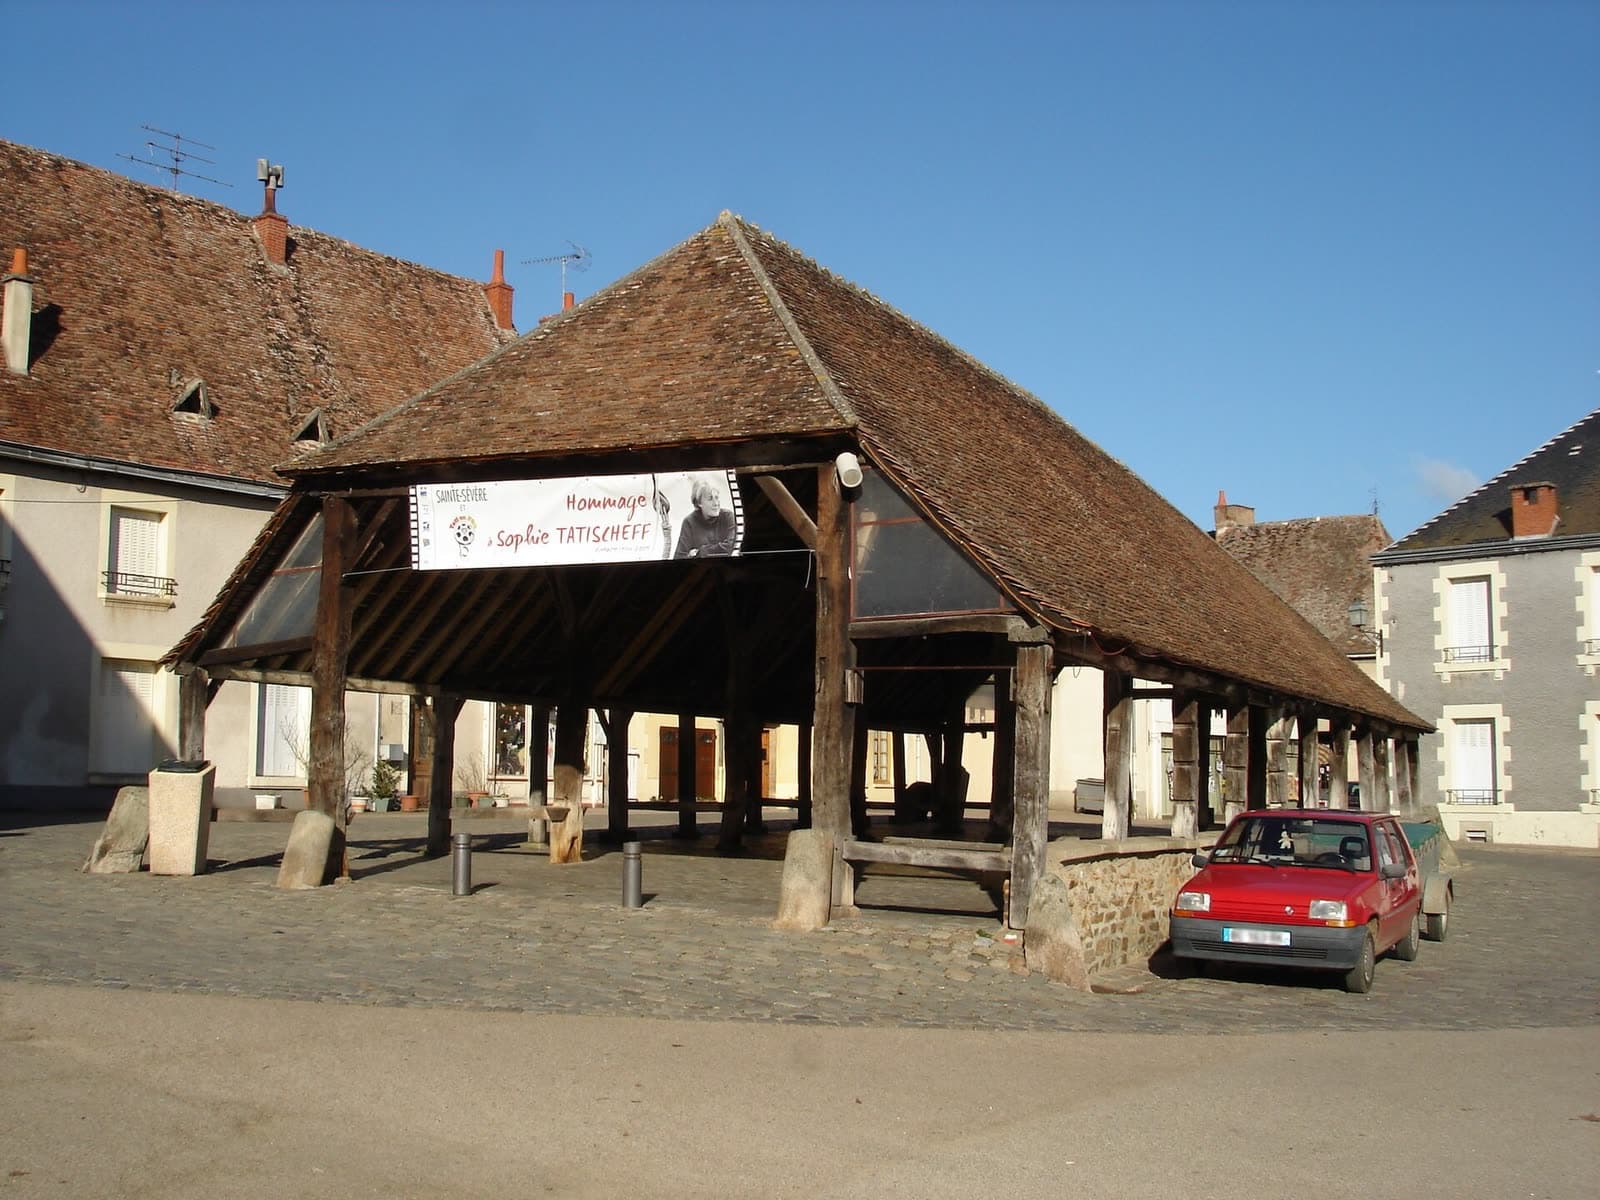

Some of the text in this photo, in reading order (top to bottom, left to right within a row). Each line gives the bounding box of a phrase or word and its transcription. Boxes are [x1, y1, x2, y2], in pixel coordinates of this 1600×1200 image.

[436, 486, 488, 503] SAINTE-SÉVÈRE
[567, 493, 647, 521] Hommage
[497, 523, 549, 552] Sophie
[556, 523, 651, 544] TATISCHEFF
